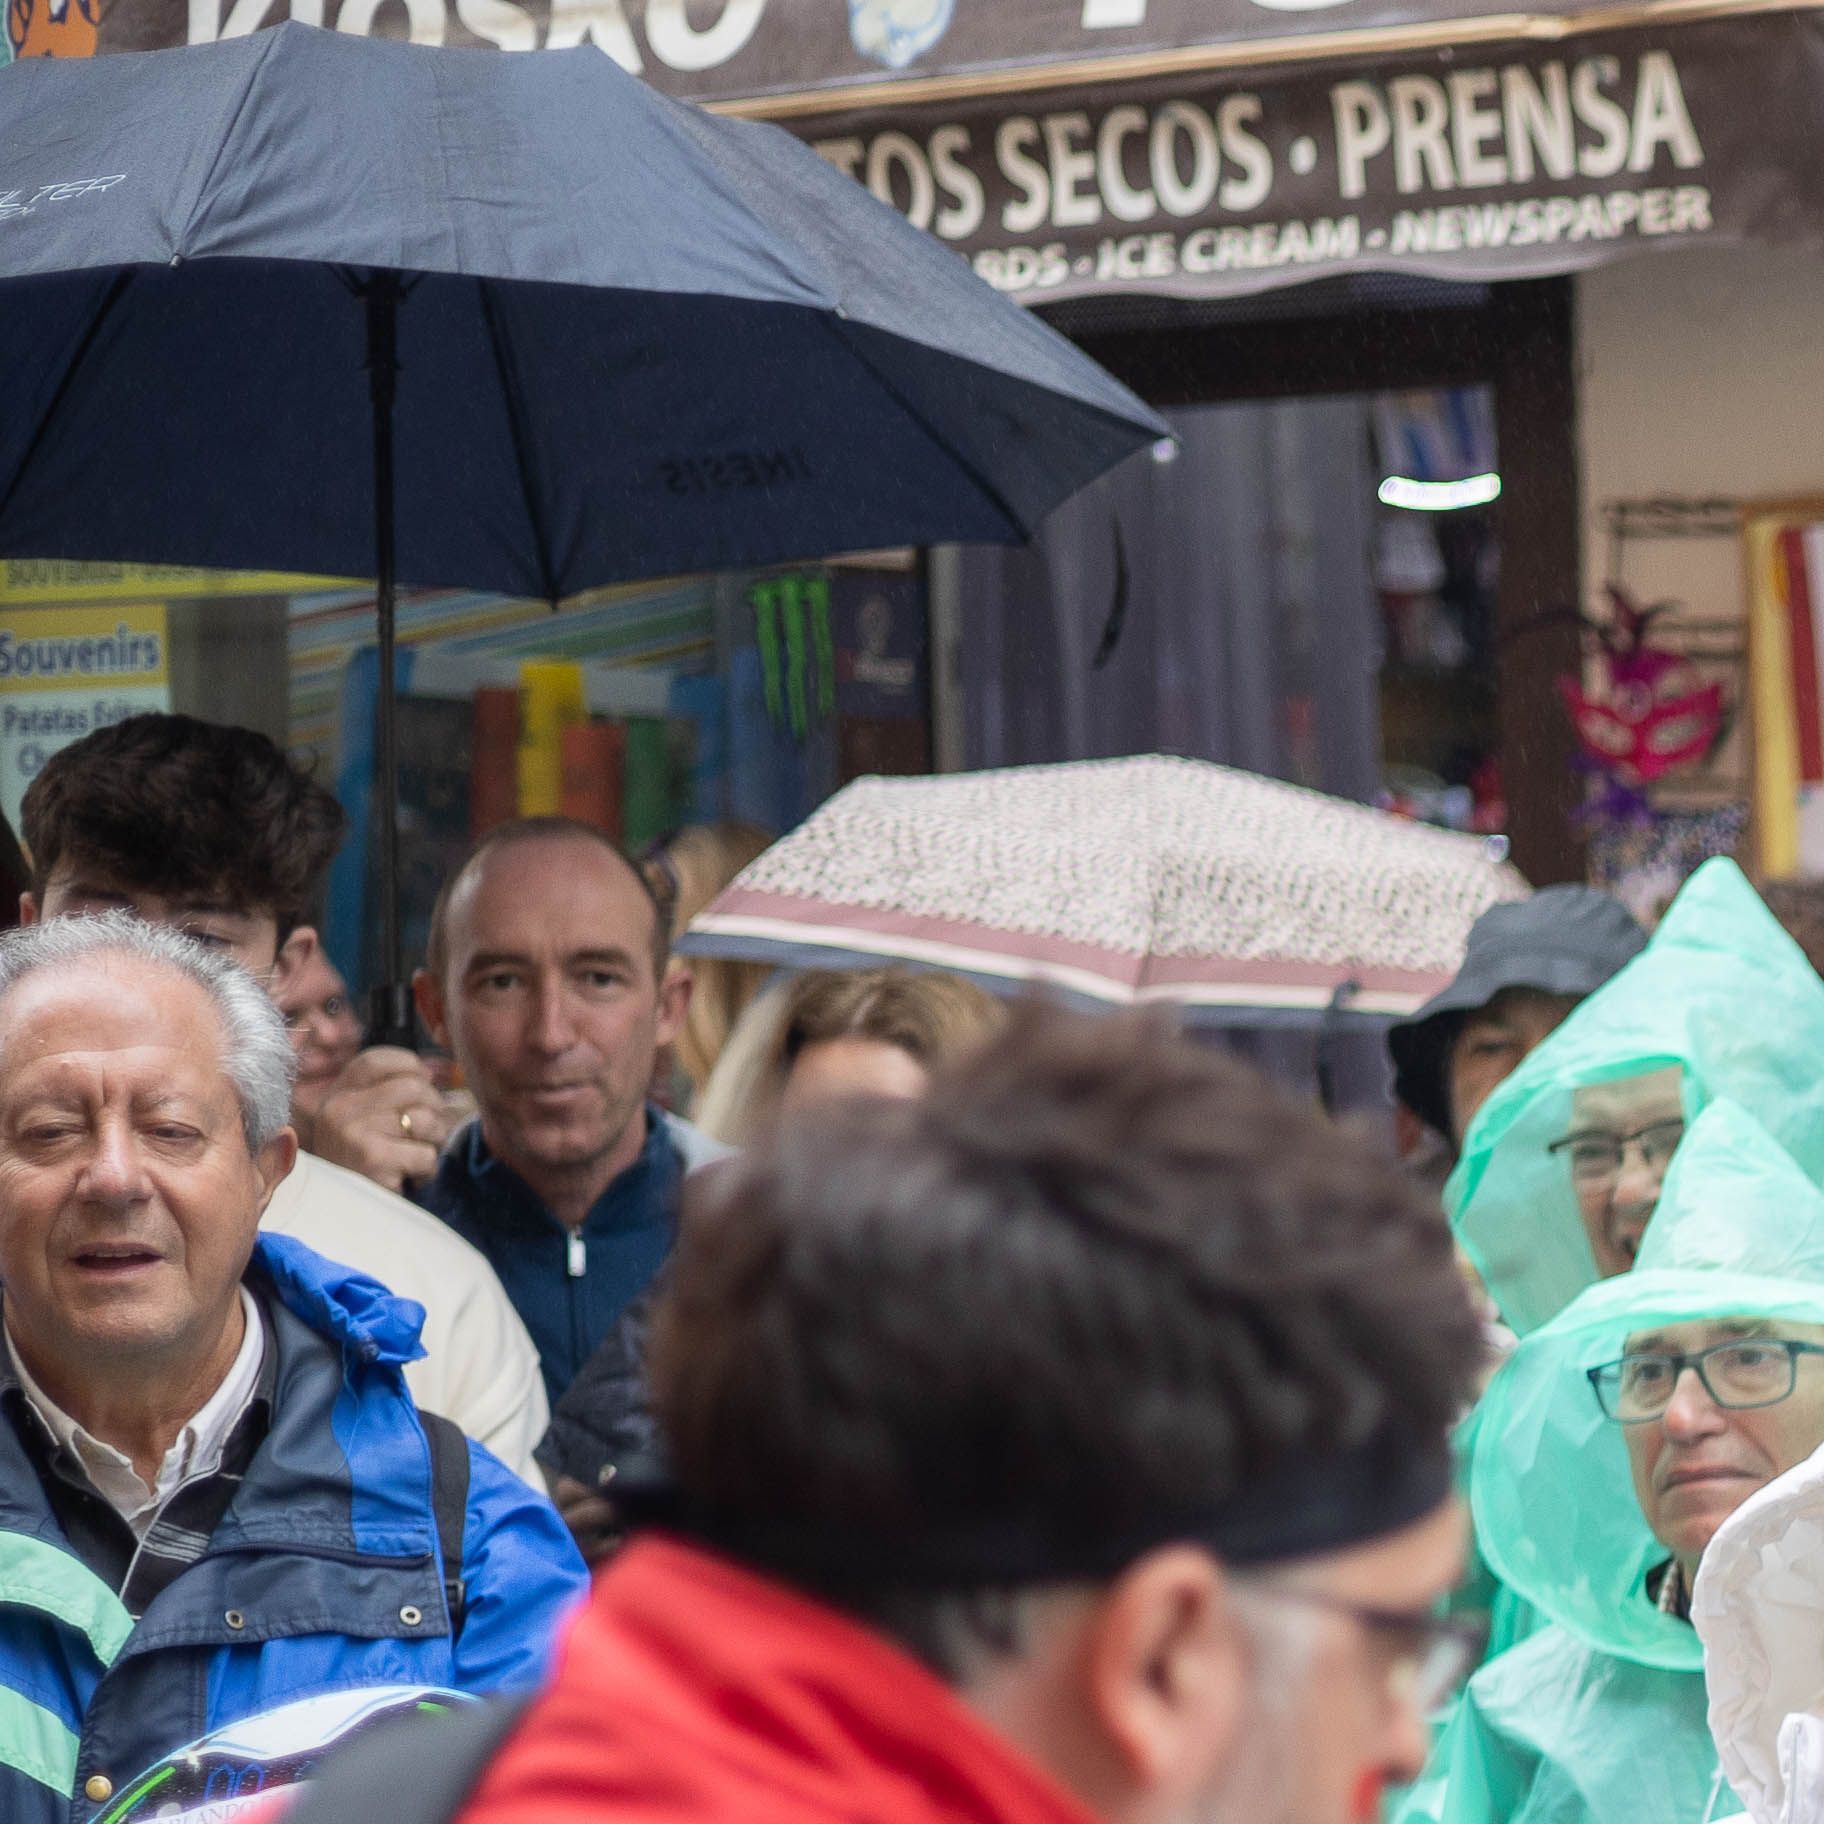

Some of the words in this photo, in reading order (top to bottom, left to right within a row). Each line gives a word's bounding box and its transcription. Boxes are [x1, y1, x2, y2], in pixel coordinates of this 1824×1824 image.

[995, 93, 1274, 234] SECOS
[1329, 48, 1706, 200] PRENSA
[1093, 232, 1178, 282] ICE
[1181, 213, 1361, 274] CREAM
[1390, 184, 1714, 255] NEWSPAPER
